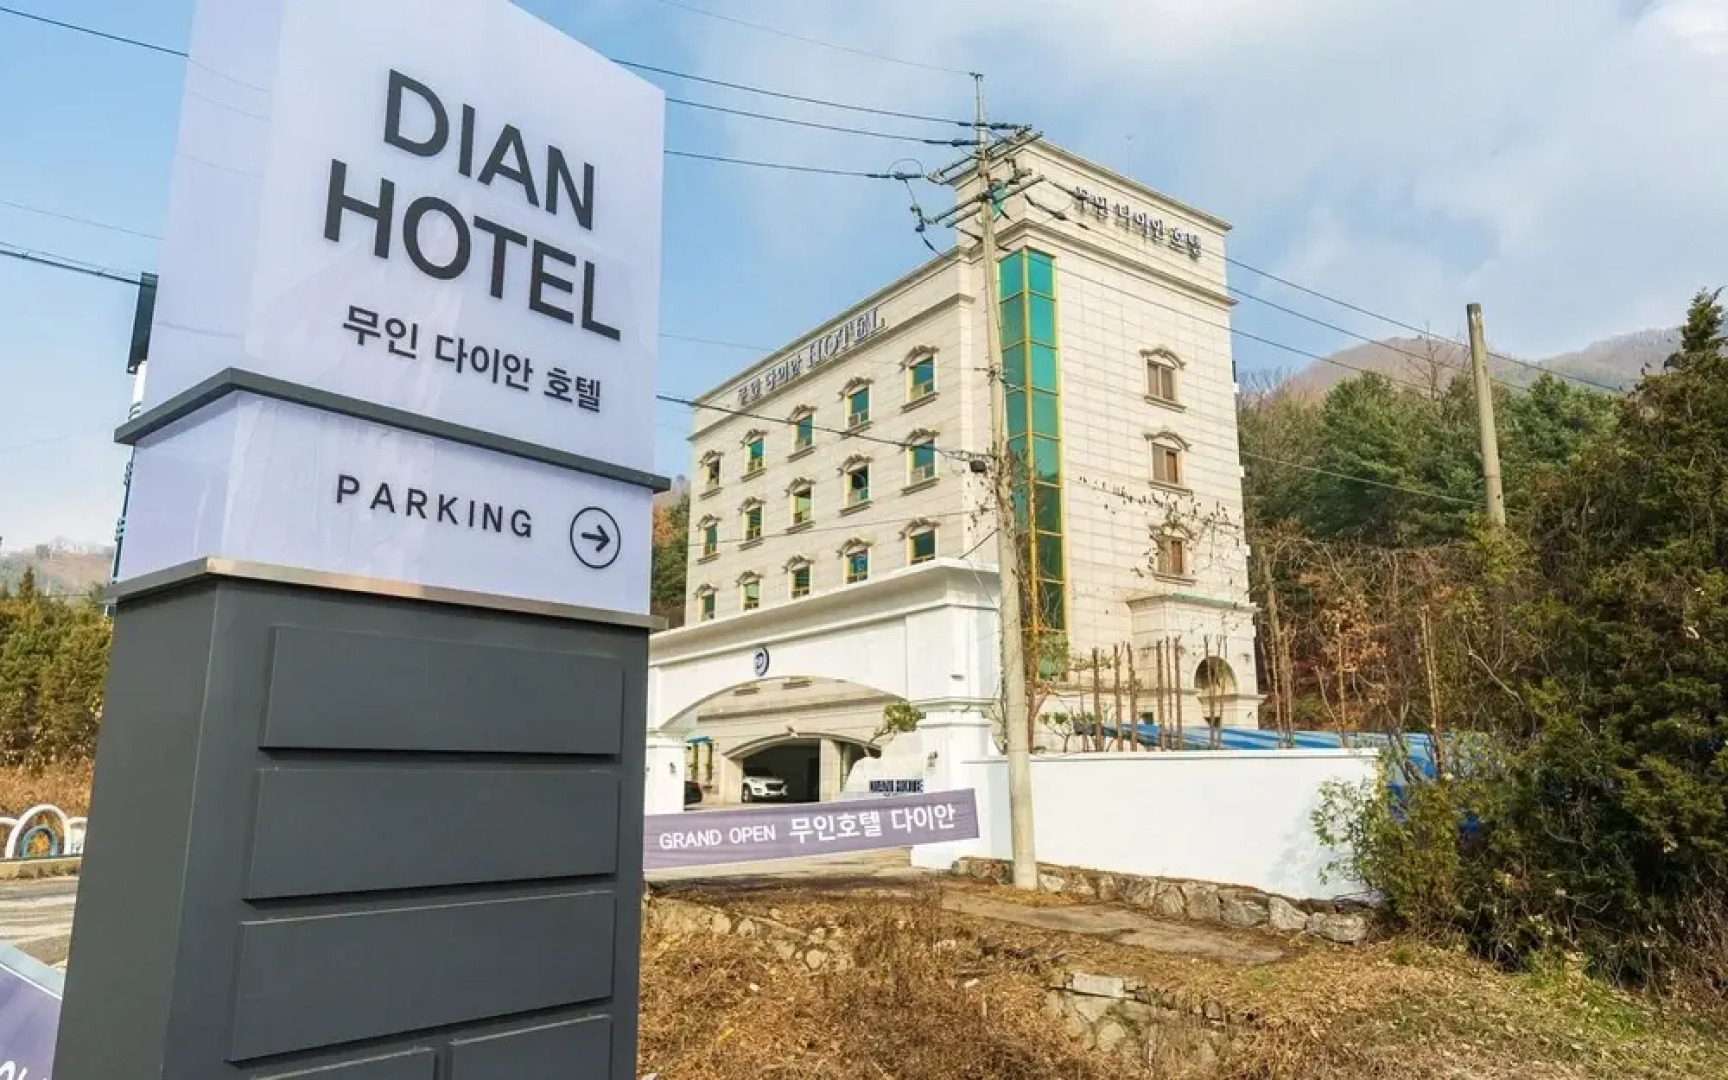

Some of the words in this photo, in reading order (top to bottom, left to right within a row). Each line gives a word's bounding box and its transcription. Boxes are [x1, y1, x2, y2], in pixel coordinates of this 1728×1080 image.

[383, 68, 596, 231] DIAN
[324, 158, 621, 341] HOTEL
[342, 304, 418, 360] 무인
[436, 336, 534, 392] 다이안
[543, 366, 602, 413] 호텔
[336, 474, 533, 539] PARKING
[659, 828, 722, 850] GRAND
[729, 824, 776, 844] OPEN
[789, 809, 882, 844] 무인호텔
[890, 803, 955, 834] 다이안
[869, 779, 894, 793] DIAN
[896, 779, 924, 793] HOTE
